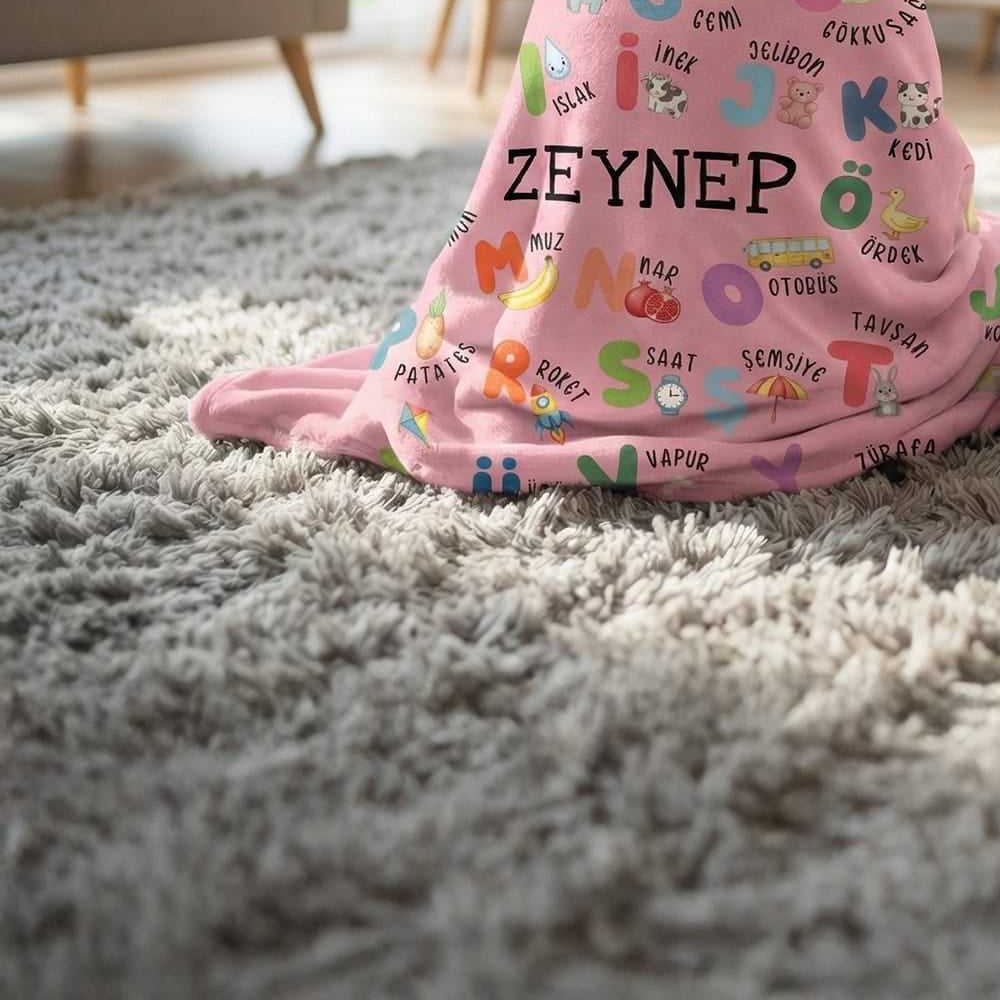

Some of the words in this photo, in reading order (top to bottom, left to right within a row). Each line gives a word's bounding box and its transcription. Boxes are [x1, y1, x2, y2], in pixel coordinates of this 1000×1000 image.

[552, 81, 596, 117] ISLAK
[720, 63, 775, 128] J
[842, 76, 897, 141] K
[888, 138, 933, 161] KEDİ
[503, 145, 797, 214] ZEYNEP
[820, 160, 872, 230] Ö
[475, 231, 528, 294] M
[530, 232, 565, 251] MUZ
[861, 236, 924, 265] ÖRDEK
[573, 247, 635, 311] N
[639, 255, 679, 286] NAR
[768, 273, 838, 297] OTOBÜS
[702, 263, 763, 326] O
[852, 311, 929, 358] TAVŞAN
[394, 342, 476, 385] PATATES
[483, 340, 530, 404] R
[535, 359, 590, 402] ROKET
[598, 340, 651, 408] S
[646, 346, 697, 372] SAAT
[741, 349, 827, 383] ŞEMSİYE
[827, 340, 894, 408] T
[646, 448, 709, 472] VAPUR
